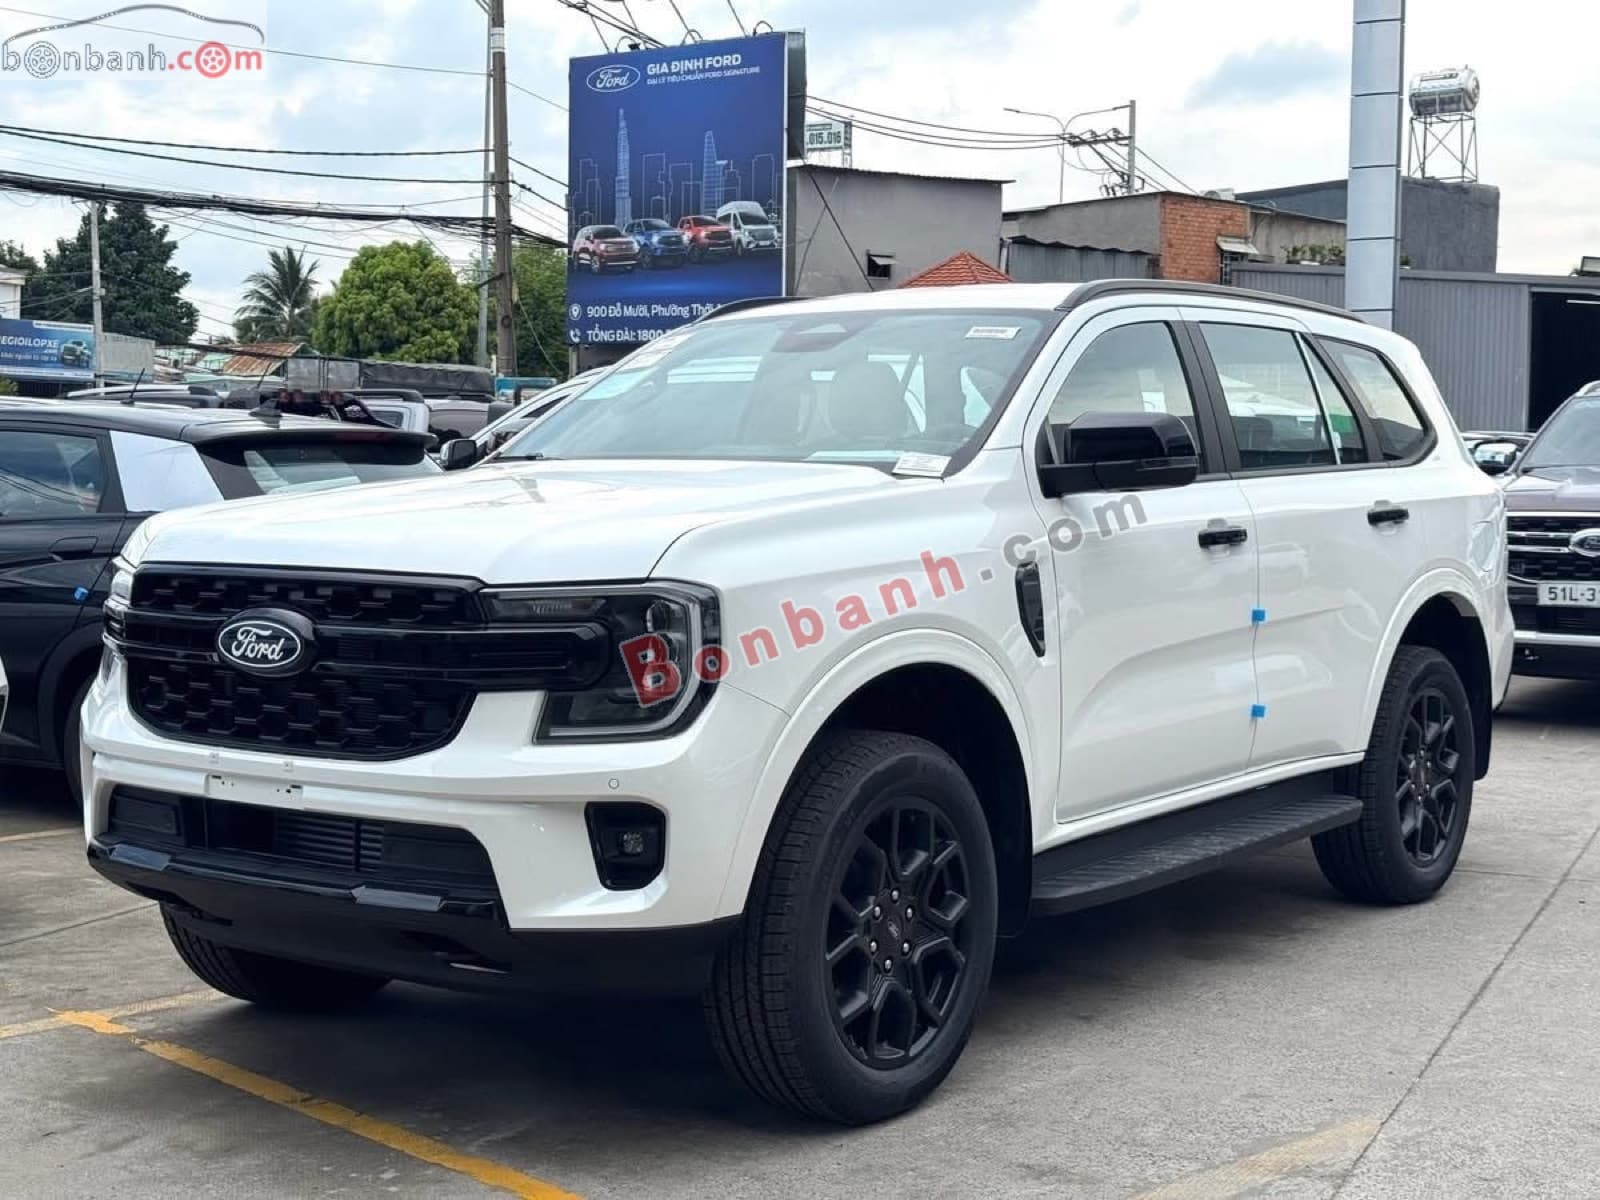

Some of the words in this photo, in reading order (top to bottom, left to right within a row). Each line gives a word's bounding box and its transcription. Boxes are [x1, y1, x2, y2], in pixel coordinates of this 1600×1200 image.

[647, 62, 670, 75] GIA
[670, 58, 703, 74] ĐỊNH
[704, 54, 742, 69] FORD
[596, 67, 630, 89] Ford
[587, 305, 607, 318] 900
[651, 303, 690, 318] Phường
[586, 323, 615, 342] TỔNG
[615, 326, 637, 342] ĐÀI:
[1547, 586, 1600, 602] 51L-3
[231, 626, 286, 660] Ford
